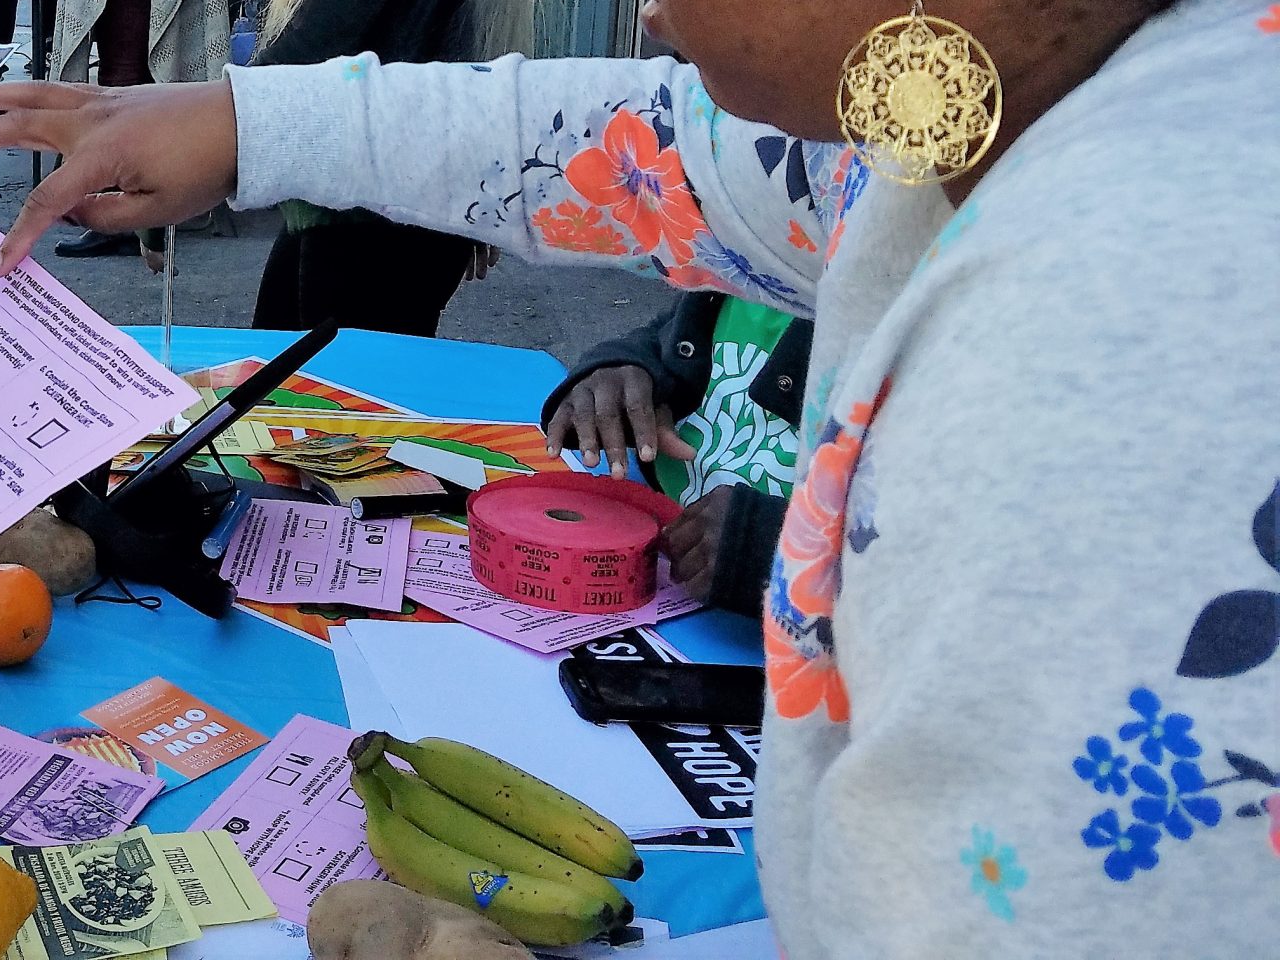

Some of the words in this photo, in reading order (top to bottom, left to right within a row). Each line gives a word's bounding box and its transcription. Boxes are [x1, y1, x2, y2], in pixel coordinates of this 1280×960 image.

[1, 287, 22, 305] prizes:
[104, 372, 126, 390] more!
[10, 279, 22, 289] all
[17, 286, 33, 300] four
[31, 296, 52, 315] activities
[49, 312, 61, 322] for
[61, 324, 78, 337] raffle
[75, 334, 92, 348] ticket
[109, 359, 117, 368] to
[116, 366, 129, 379] win
[21, 274, 44, 294] THREE
[40, 291, 62, 308] AMIGOS
[57, 304, 80, 324] GRAND
[77, 321, 100, 340] OPENING
[111, 346, 147, 377] ACTIVITIES
[141, 373, 174, 396] PASSPORT
[12, 342, 35, 362] answer
[43, 385, 78, 417] SCAVENGER
[67, 387, 81, 402] the
[79, 400, 100, 417] Corner
[96, 413, 114, 427] Store
[13, 467, 24, 478] the
[514, 543, 559, 560] COUPON
[583, 548, 626, 568] COUPON
[520, 559, 549, 572] KEEP
[590, 565, 618, 580] KEEP
[514, 579, 555, 602] TICKET
[581, 585, 624, 611] TICKET
[134, 706, 211, 746] OPEN
[160, 720, 230, 757] NOW
[318, 764, 331, 775] OUT
[326, 756, 339, 765] FILL
[332, 762, 346, 774] FREE
[33, 759, 65, 788] VEGETARIAN
[667, 742, 755, 812] HOPE
[23, 785, 40, 796] RED
[298, 777, 319, 795] SURVEY.
[309, 779, 329, 797] sample
[302, 796, 314, 806] and
[271, 812, 287, 827] SHOP
[258, 826, 275, 841] WITH
[273, 827, 288, 838] Take
[245, 839, 264, 854] HOPE
[257, 840, 274, 856] photo
[162, 846, 195, 874] THREE
[248, 854, 260, 867] with
[317, 850, 346, 880] SCAVENGER
[338, 843, 364, 870] Complete
[27, 853, 47, 883] ENSALADA
[332, 866, 345, 879] the
[38, 883, 49, 891] DE
[177, 877, 212, 907] AMIGOS
[304, 875, 323, 894] HUNT.
[318, 875, 337, 895] Corner
[40, 890, 57, 911] MANGO
[50, 916, 67, 935] FRIJOL
[57, 935, 75, 956] NEGRO
